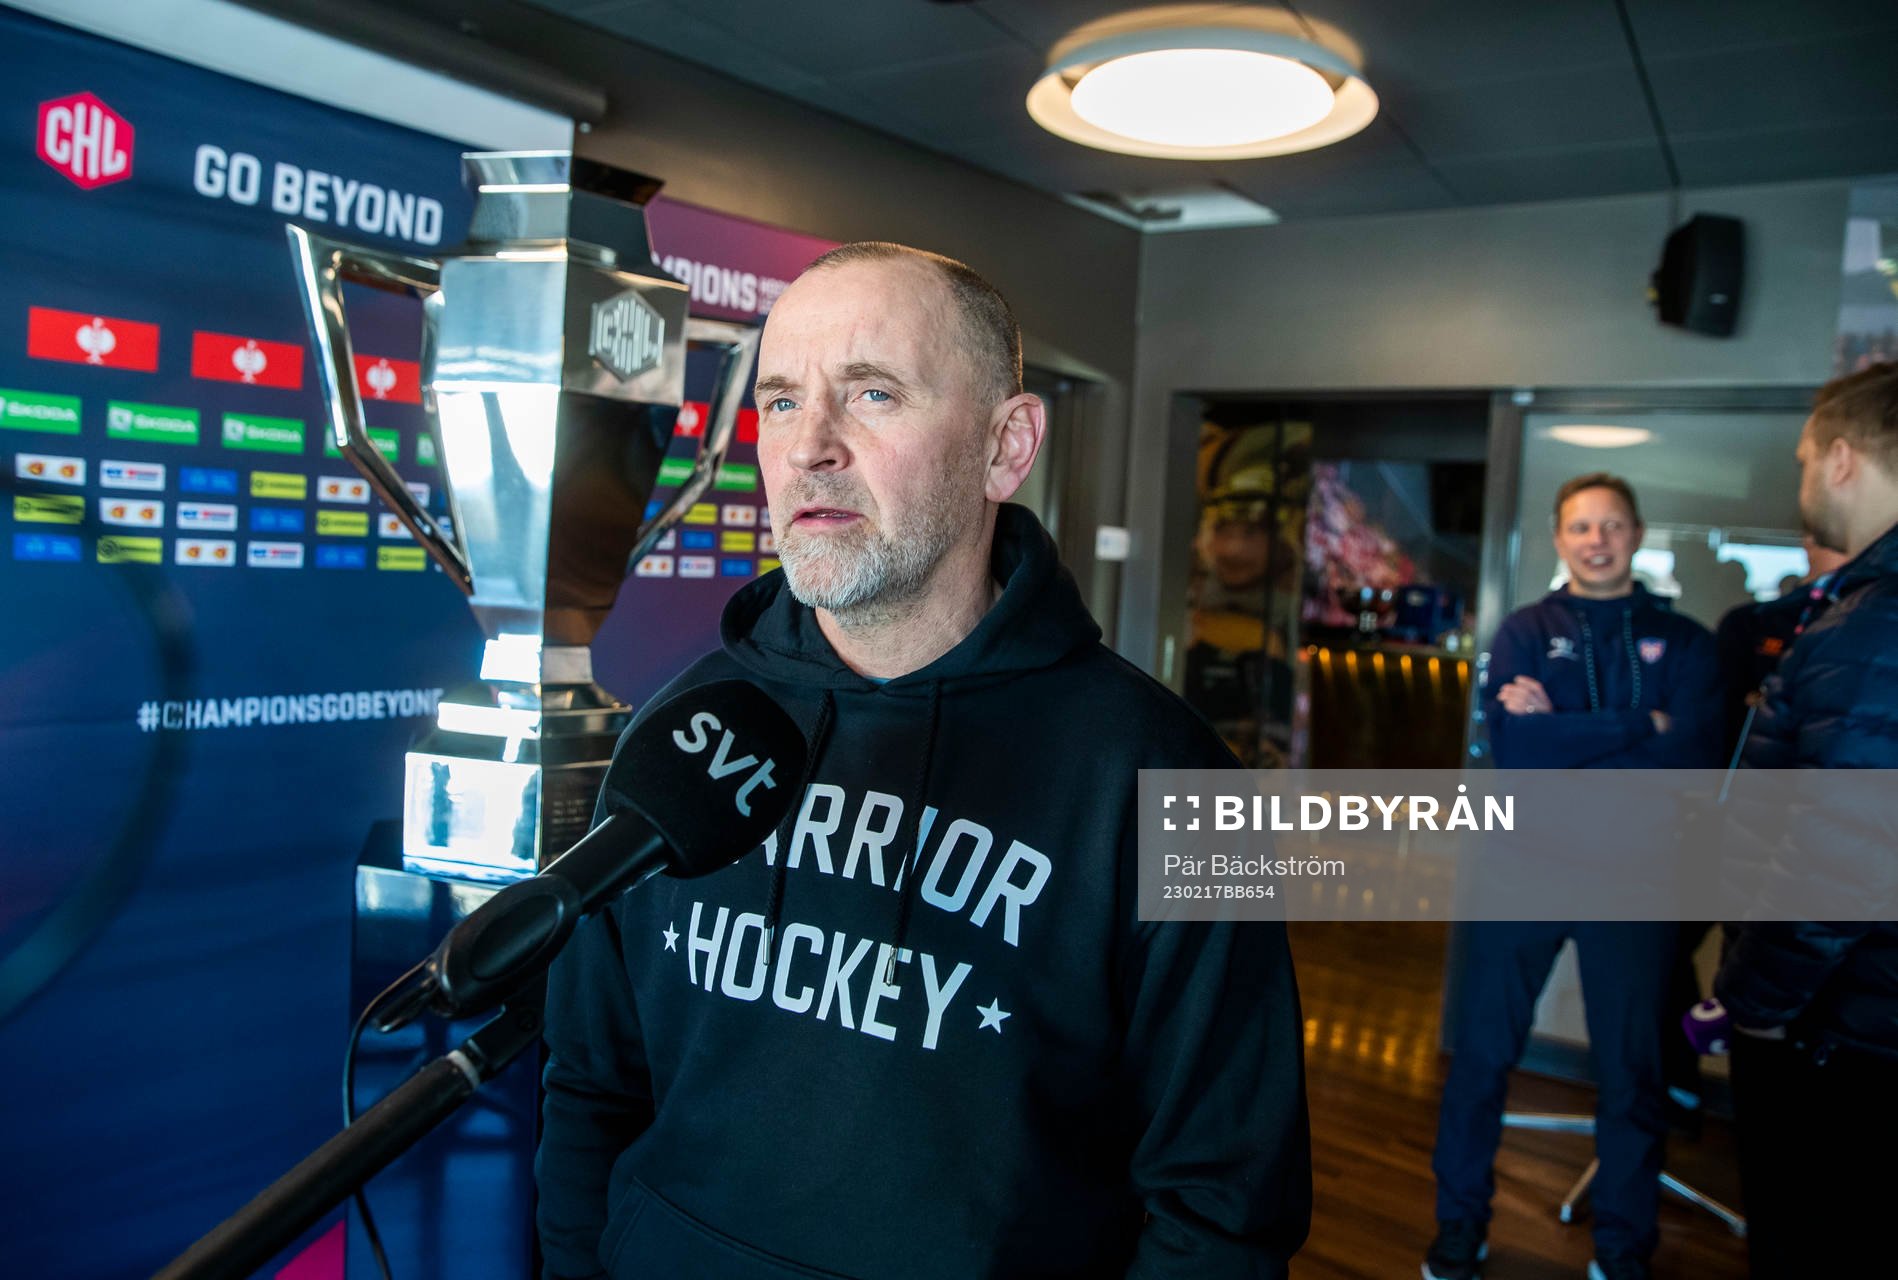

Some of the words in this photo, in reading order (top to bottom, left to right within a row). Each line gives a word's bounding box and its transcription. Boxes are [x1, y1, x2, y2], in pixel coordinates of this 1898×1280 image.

[44, 101, 127, 180] CHL
[194, 144, 261, 206] GO
[272, 162, 443, 245] BEYOND
[651, 251, 758, 312] PIONS
[672, 711, 777, 818] svt
[762, 783, 1052, 948] RRIOR
[687, 902, 972, 1050] HOCKEY
